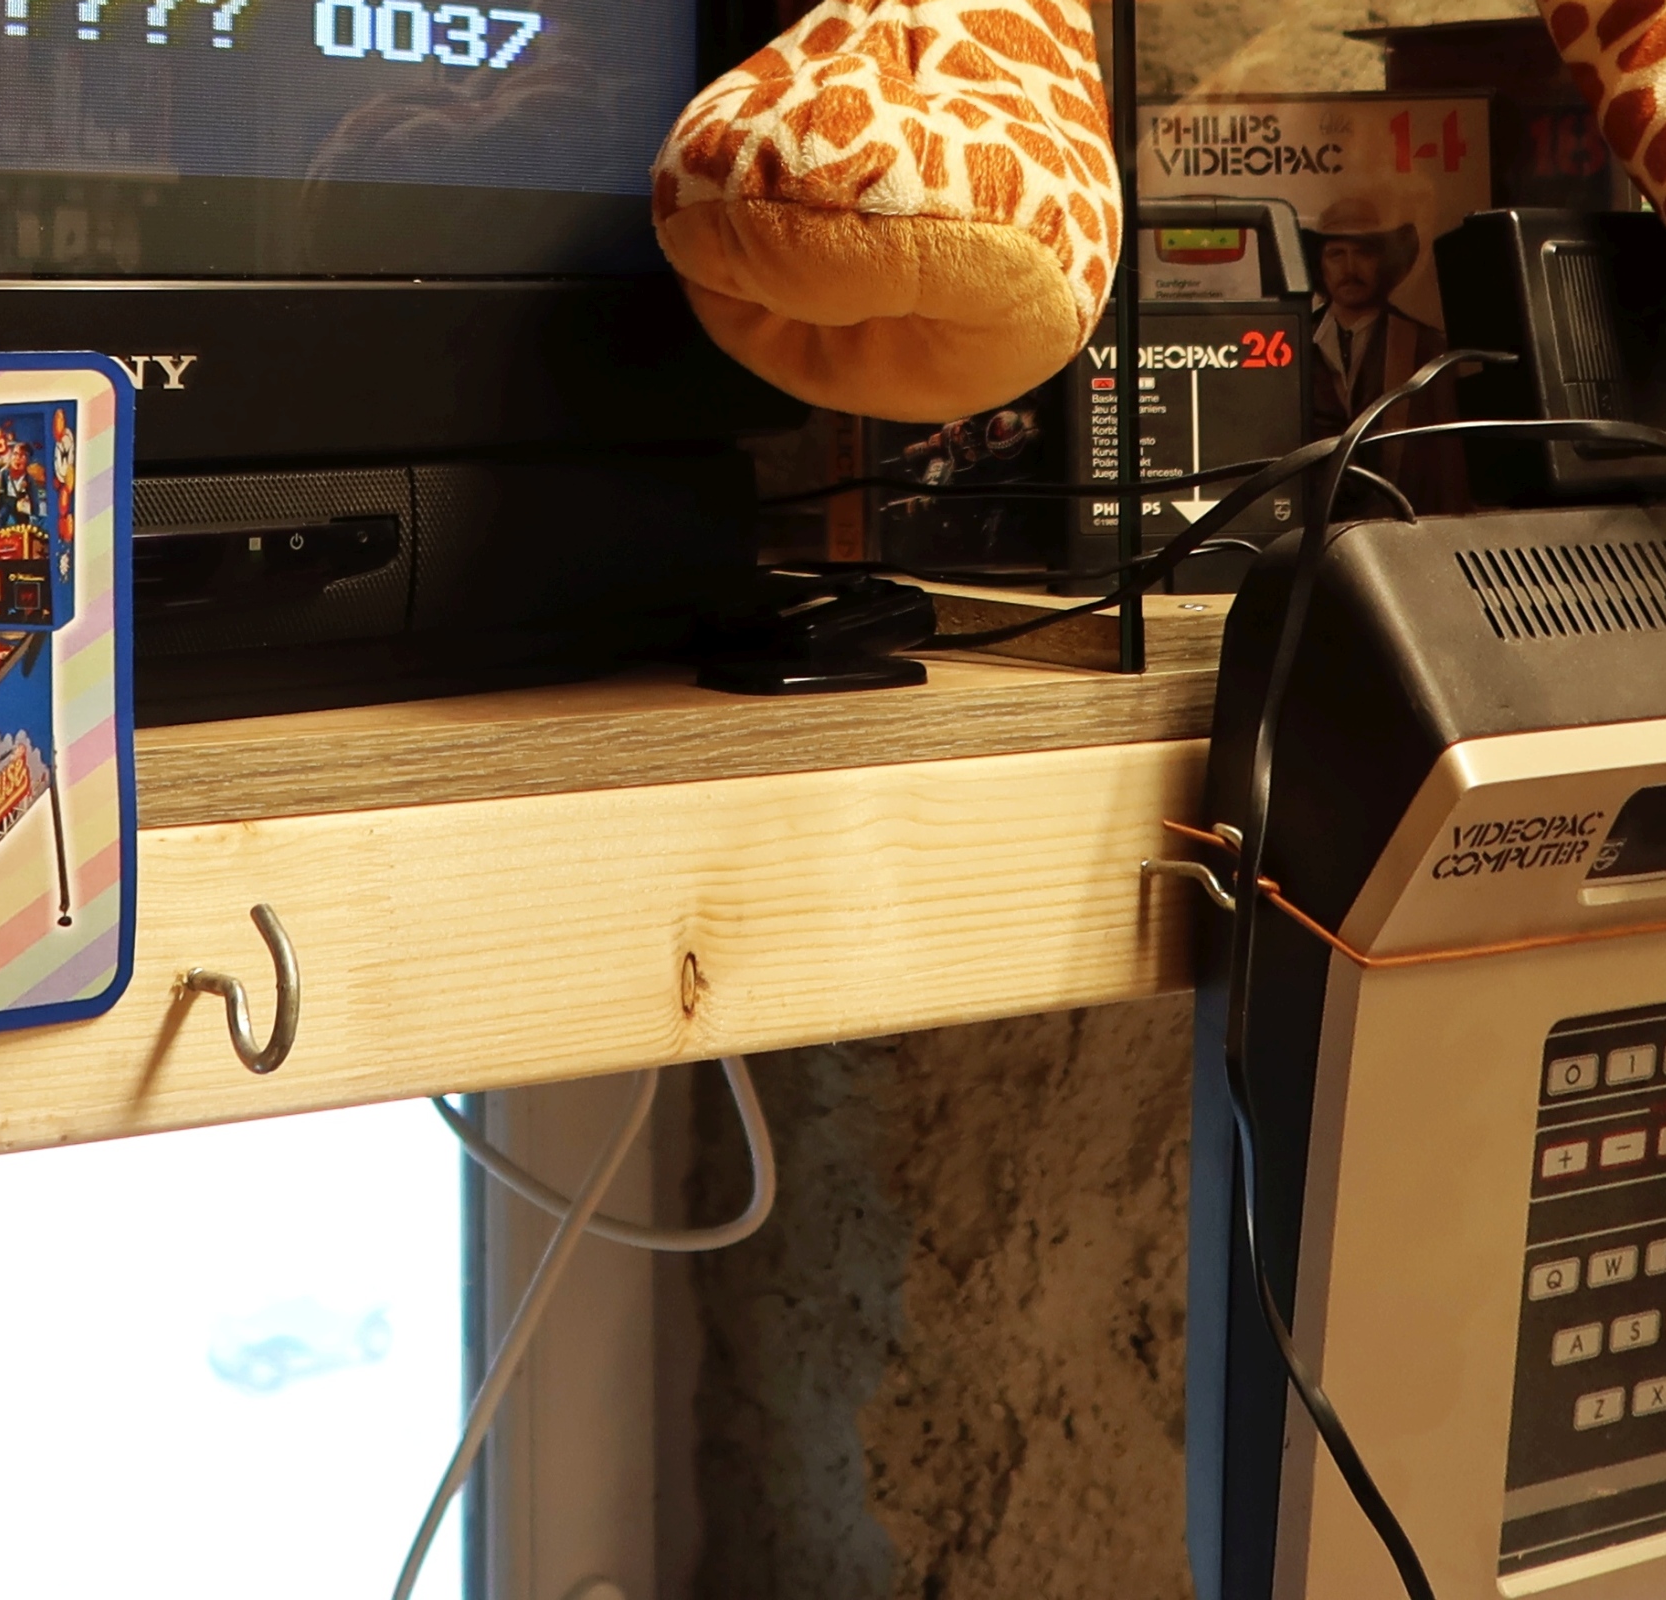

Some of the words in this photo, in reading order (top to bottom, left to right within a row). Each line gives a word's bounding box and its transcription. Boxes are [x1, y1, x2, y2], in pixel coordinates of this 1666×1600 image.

[1152, 115, 1281, 145] PHILIPS
[1153, 143, 1344, 177] VIDEOPAC
[1241, 331, 1293, 368] 26
[110, 355, 198, 390] NY
[1092, 405, 1109, 414] Jeu
[1093, 437, 1110, 446] Tiro
[1093, 502, 1162, 516] PHIPS
[1452, 811, 1604, 849] VIDEOPAC
[1433, 840, 1590, 880] COMPUTER
[1547, 1268, 1563, 1291] Q
[1604, 1258, 1622, 1278] W
[1569, 1334, 1584, 1354] A
[1629, 1321, 1641, 1342] S
[1593, 1399, 1605, 1419] Z
[1651, 1385, 1664, 1405] X
